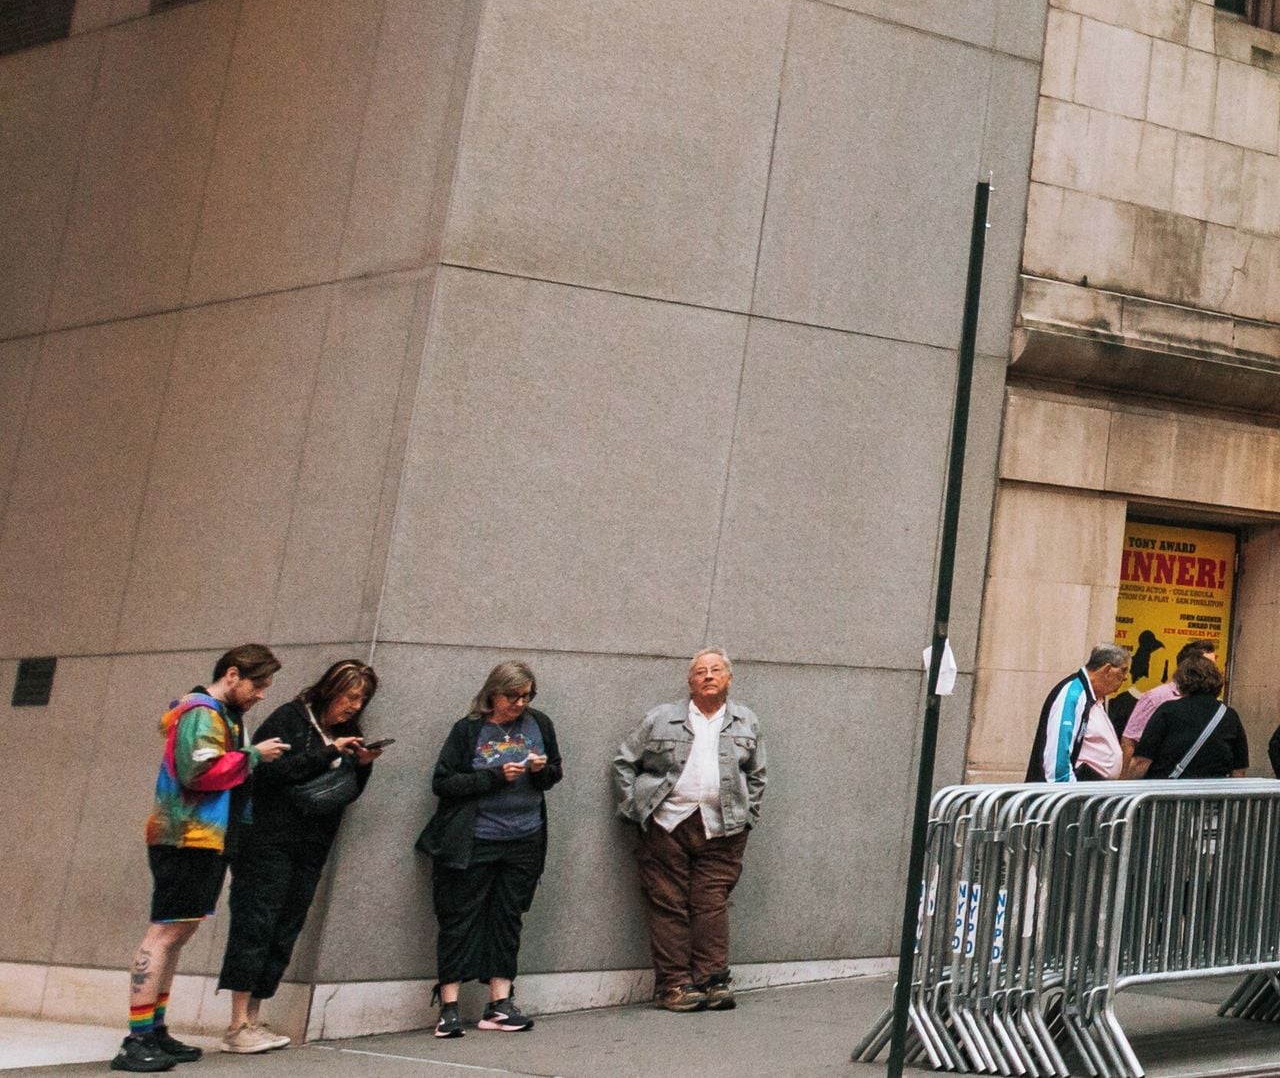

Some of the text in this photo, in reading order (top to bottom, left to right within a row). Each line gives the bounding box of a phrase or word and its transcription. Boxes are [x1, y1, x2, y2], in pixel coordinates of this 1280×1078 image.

[1120, 549, 1227, 590] INNER!
[1128, 536, 1197, 554] TONY AWARD
[952, 884, 967, 950] NYPD
[966, 888, 979, 955] NYPD
[992, 893, 1006, 960] NYPD
